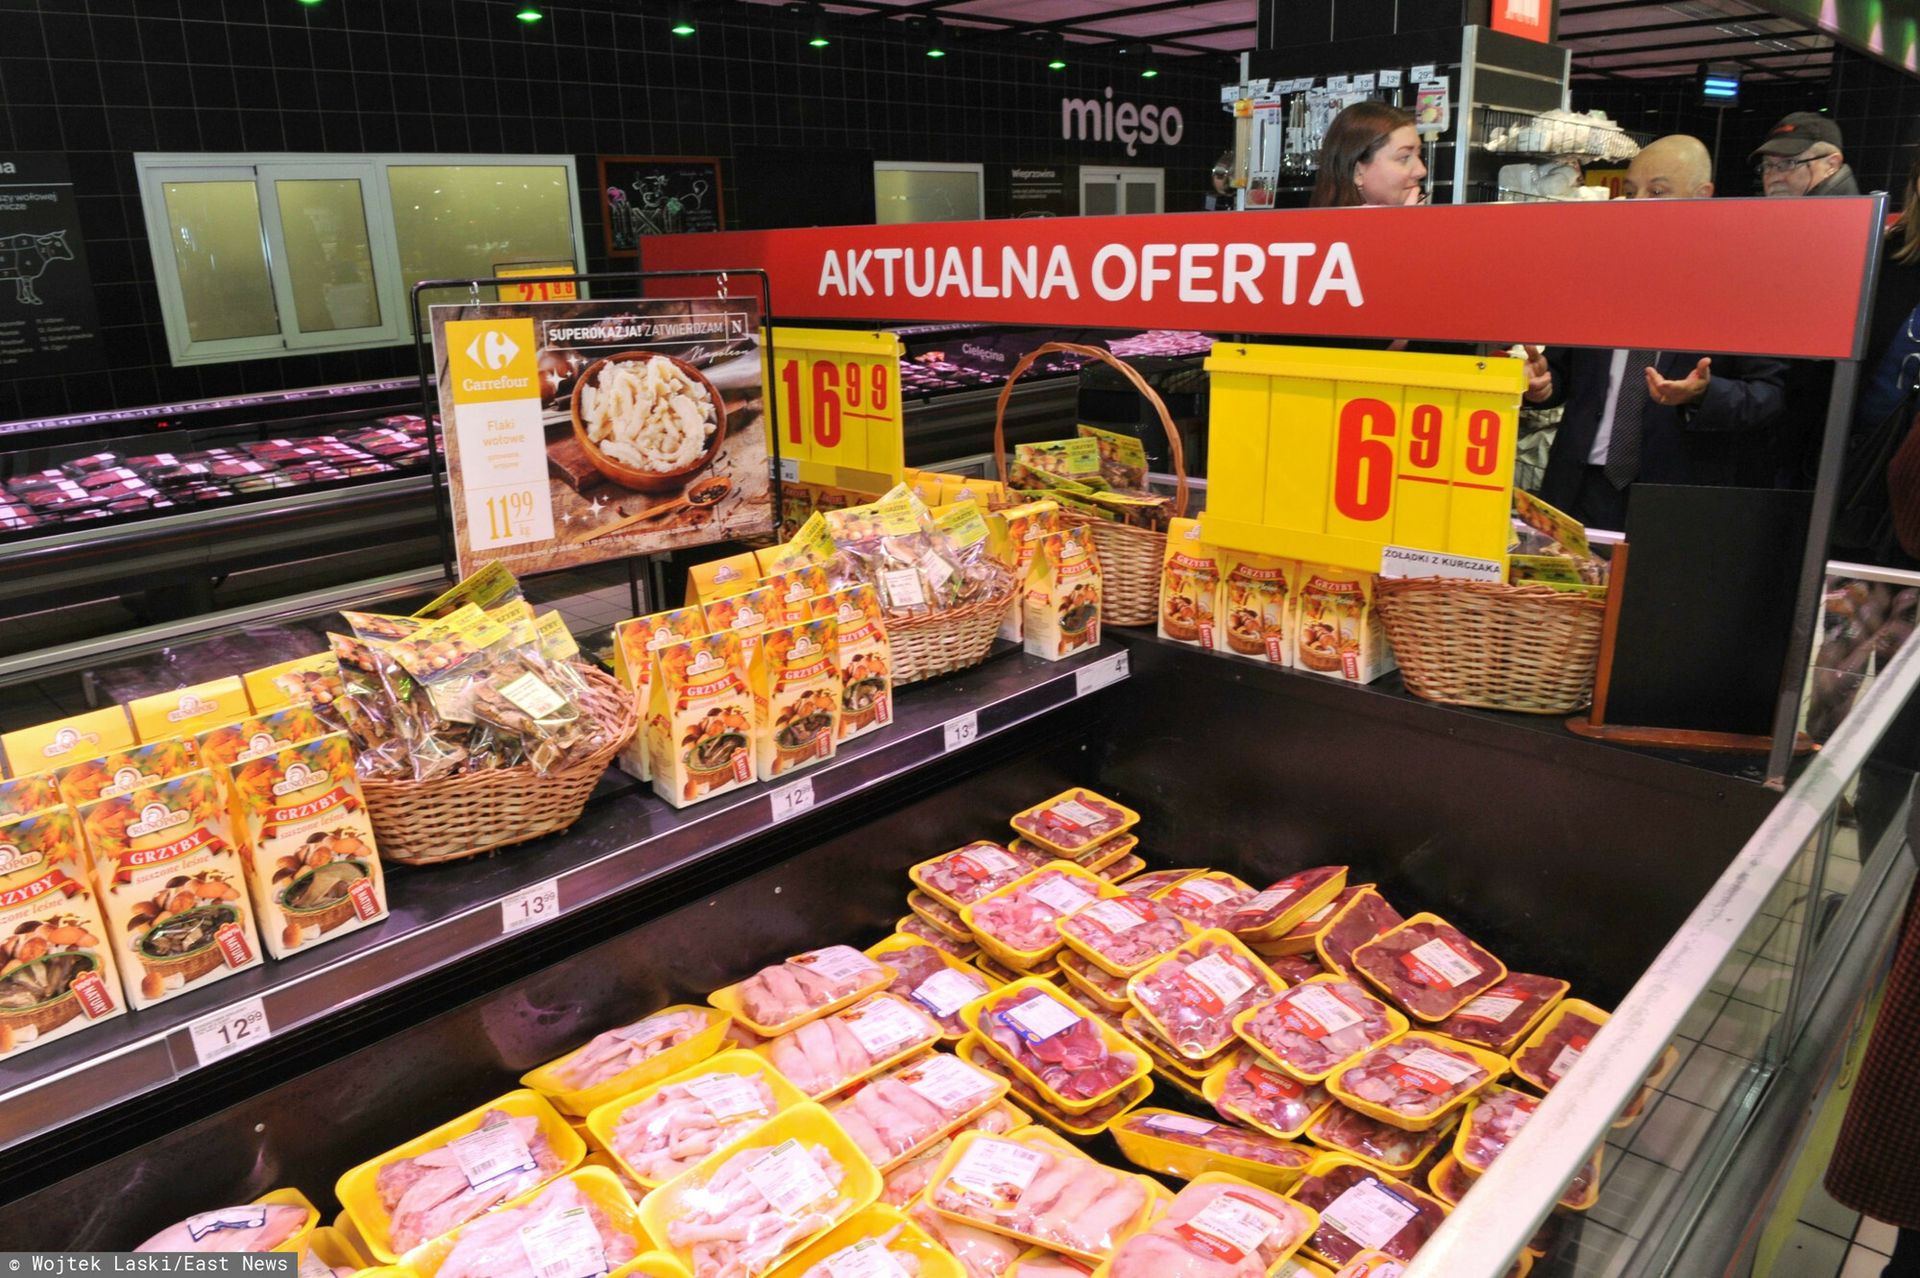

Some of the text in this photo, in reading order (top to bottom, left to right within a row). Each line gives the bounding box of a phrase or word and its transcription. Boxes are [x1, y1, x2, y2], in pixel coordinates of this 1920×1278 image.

[1062, 86, 1184, 157] mięso
[818, 241, 1365, 307] AKTUALNA OFERTA
[644, 322, 724, 337] ZATWIERDZAM
[731, 319, 742, 334] N
[962, 343, 1005, 363] Cielęcina
[462, 376, 529, 392] Carrefour
[487, 418, 515, 432] Flaki
[1176, 553, 1210, 568] GRZYBY
[1432, 556, 1438, 564] Z
[1441, 557, 1500, 573] KURCZAKA
[1240, 565, 1279, 579] GRZYBY
[1314, 578, 1355, 592] GRZYBY
[785, 661, 826, 680] GRZYBY
[687, 676, 732, 697] GRZYBY
[277, 771, 327, 792] RUNOPOL
[275, 791, 339, 822] GRZYBY
[133, 813, 187, 834] RUNOPOL
[130, 832, 202, 866] GRZYBY
[0, 875, 54, 907] ZYBY
[32, 897, 64, 914] leśne
[356, 889, 378, 917] NATURY
[223, 936, 248, 964] NATURY
[81, 985, 109, 1015] NATURY
